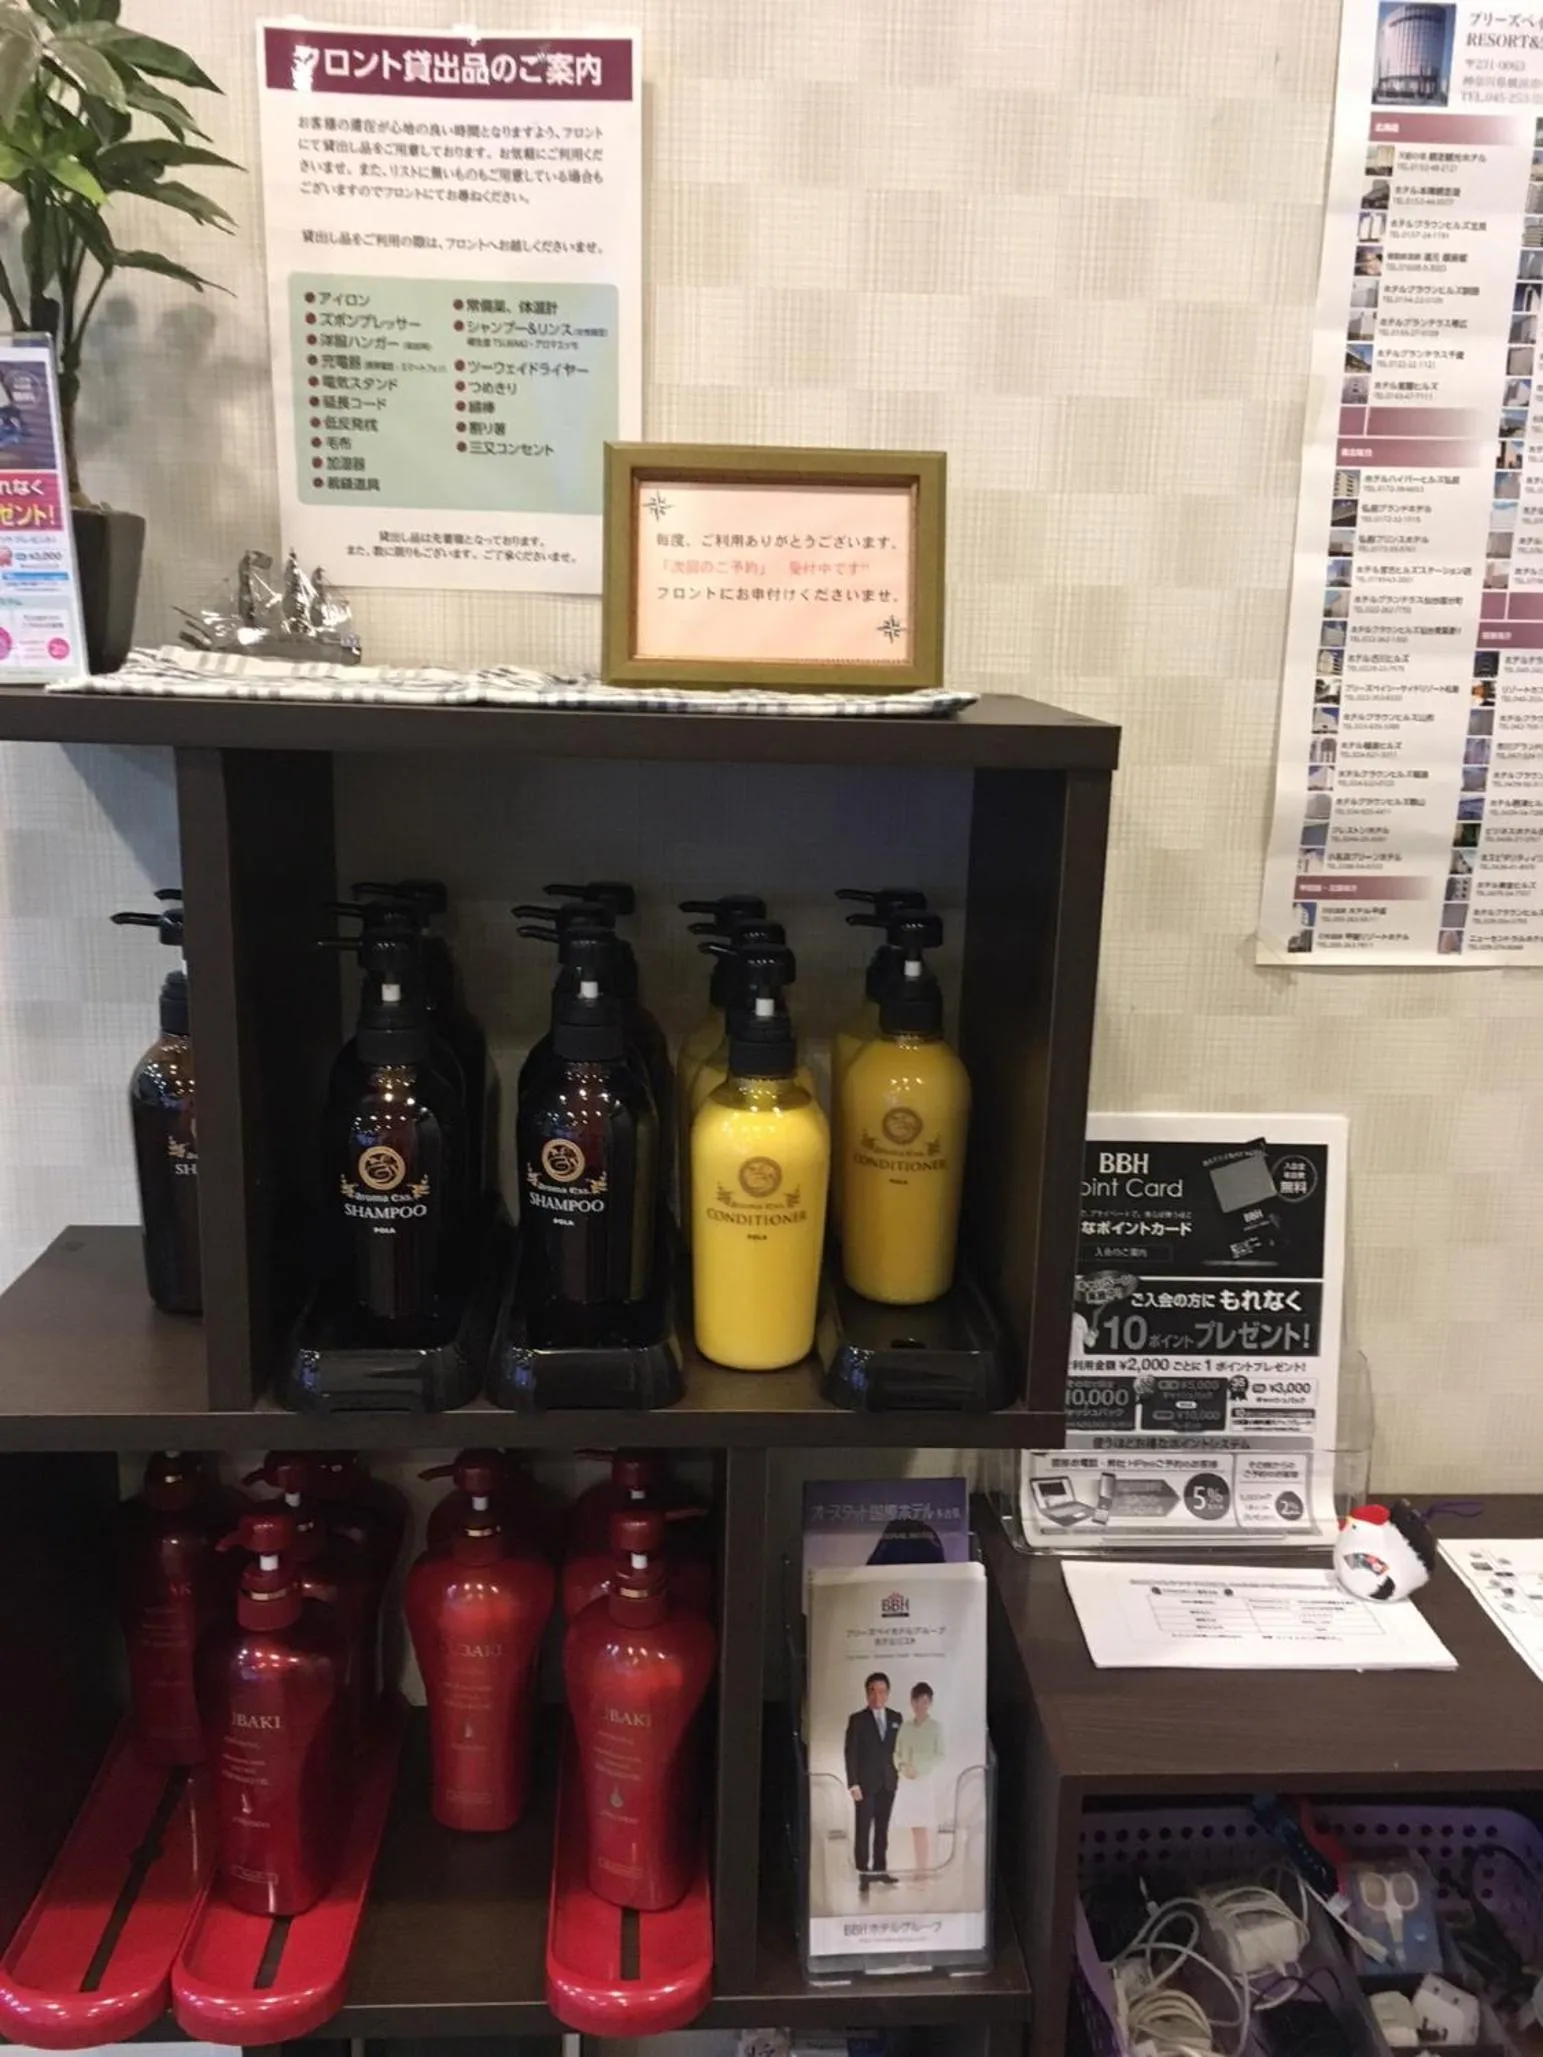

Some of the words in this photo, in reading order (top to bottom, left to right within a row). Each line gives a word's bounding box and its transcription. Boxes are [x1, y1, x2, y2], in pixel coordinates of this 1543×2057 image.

[318, 291, 371, 308] アイロン
[319, 313, 421, 329] ズボンプレッサー
[320, 334, 399, 351] 洋服ハンガー
[321, 355, 361, 370] 充電器
[468, 360, 589, 376] ツーウェイドライヤー
[322, 376, 398, 391] 電気スタンド
[469, 381, 517, 395] つめきり
[324, 396, 387, 411] 延長コード
[326, 436, 351, 450] 毛布
[327, 457, 365, 471] 加湿器
[656, 532, 898, 550] 毎度、ご利用ありがとうございます。
[657, 587, 900, 602] フロントにお申付けくださいませ。
[854, 1155, 947, 1171] CONDITIONER
[1099, 1152, 1149, 1175] BBH
[1125, 1179, 1184, 1198] Card
[1280, 1181, 1308, 1194] 無料
[530, 1192, 605, 1213] SHAMPOO
[343, 1203, 428, 1220] SHAMPOO
[706, 1208, 808, 1225] CONDITIONER
[1081, 1221, 1192, 1236] なポイントカード
[1131, 1292, 1216, 1308] ご入会の方に
[1220, 1290, 1302, 1312] もれなく
[1120, 1358, 1170, 1373] ¥2,000
[1173, 1361, 1201, 1371] ごとに
[1204, 1360, 1211, 1371] 1
[1216, 1361, 1306, 1372] ポイントプレゼント!
[1270, 1382, 1312, 1394] ¥3,000
[881, 1597, 909, 1612] BBH
